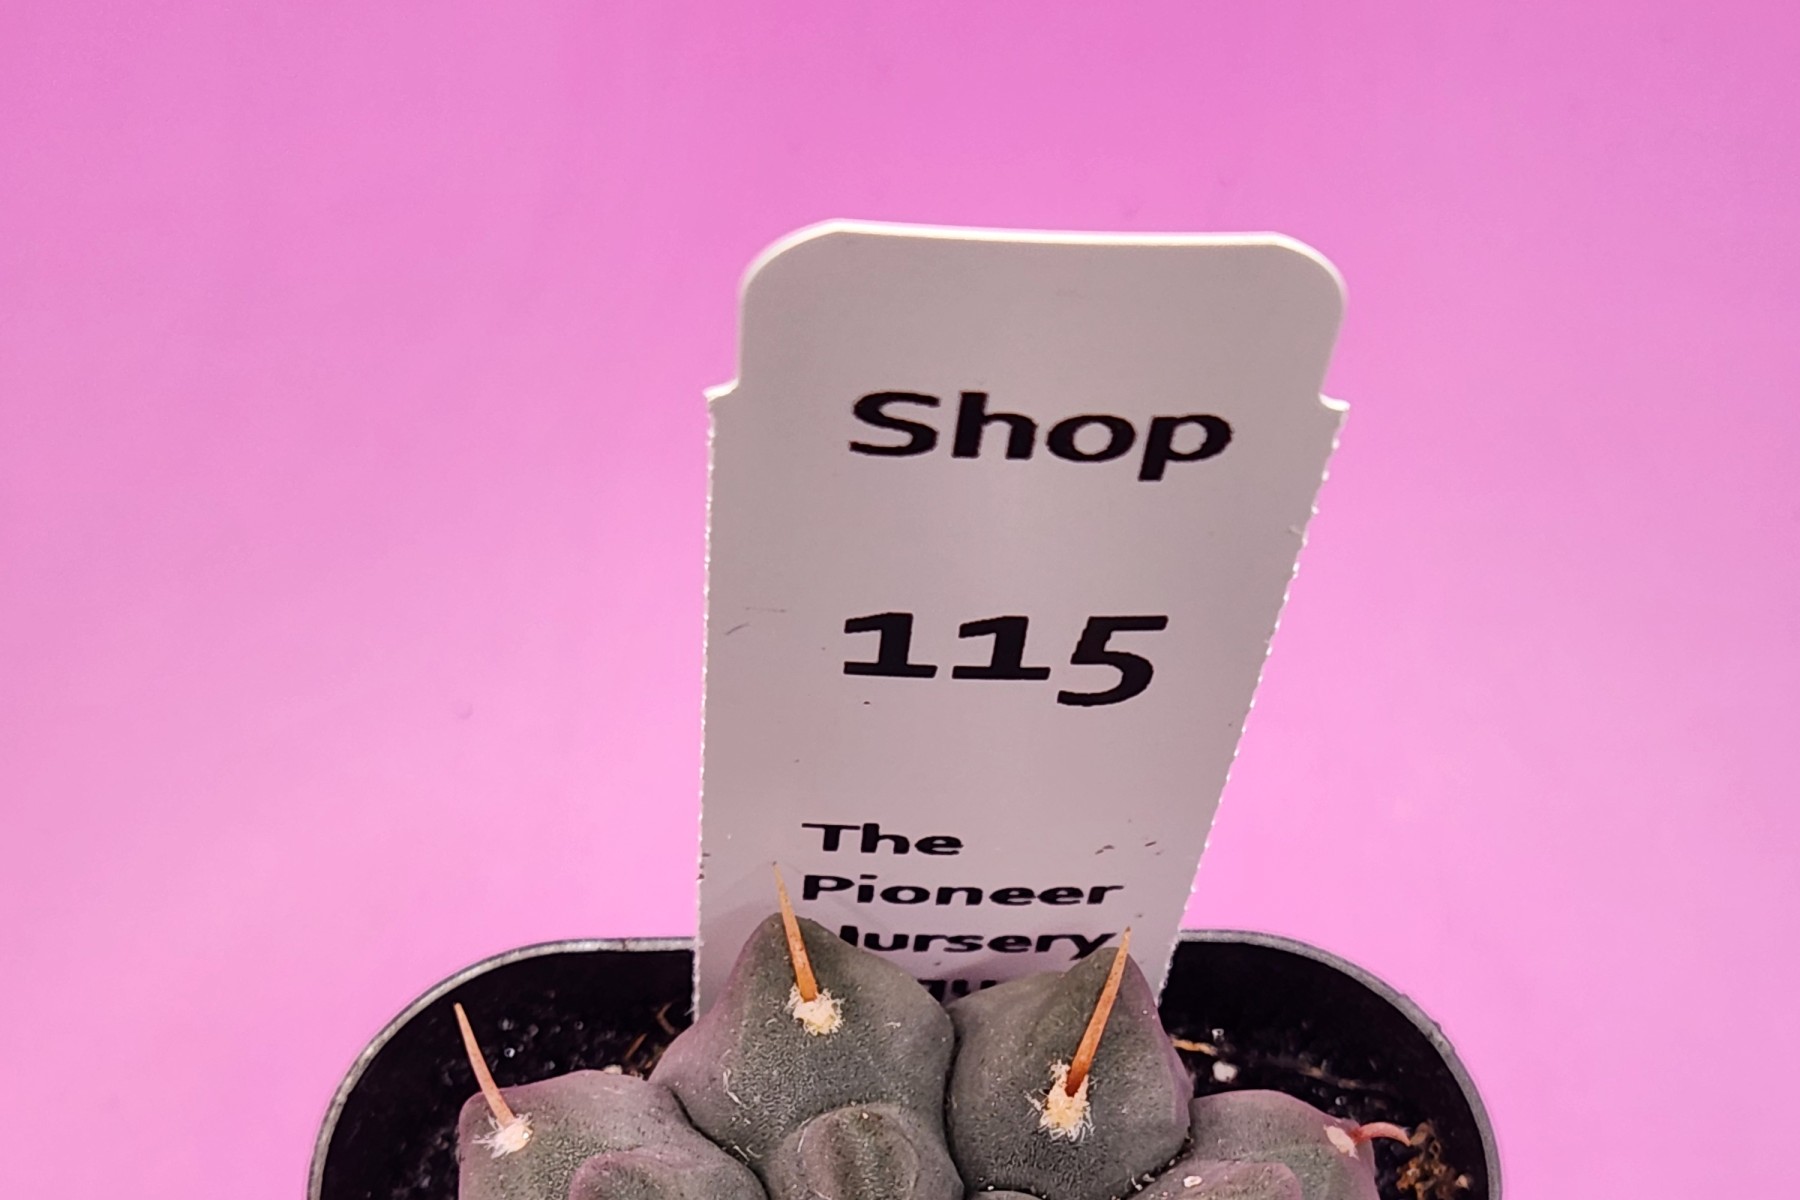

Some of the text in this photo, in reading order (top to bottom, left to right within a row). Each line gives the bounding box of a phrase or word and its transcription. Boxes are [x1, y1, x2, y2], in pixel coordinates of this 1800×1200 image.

[848, 391, 1234, 482] Shop
[843, 612, 1168, 707] 115
[801, 823, 964, 855] The
[802, 874, 1124, 906] Pioneer
